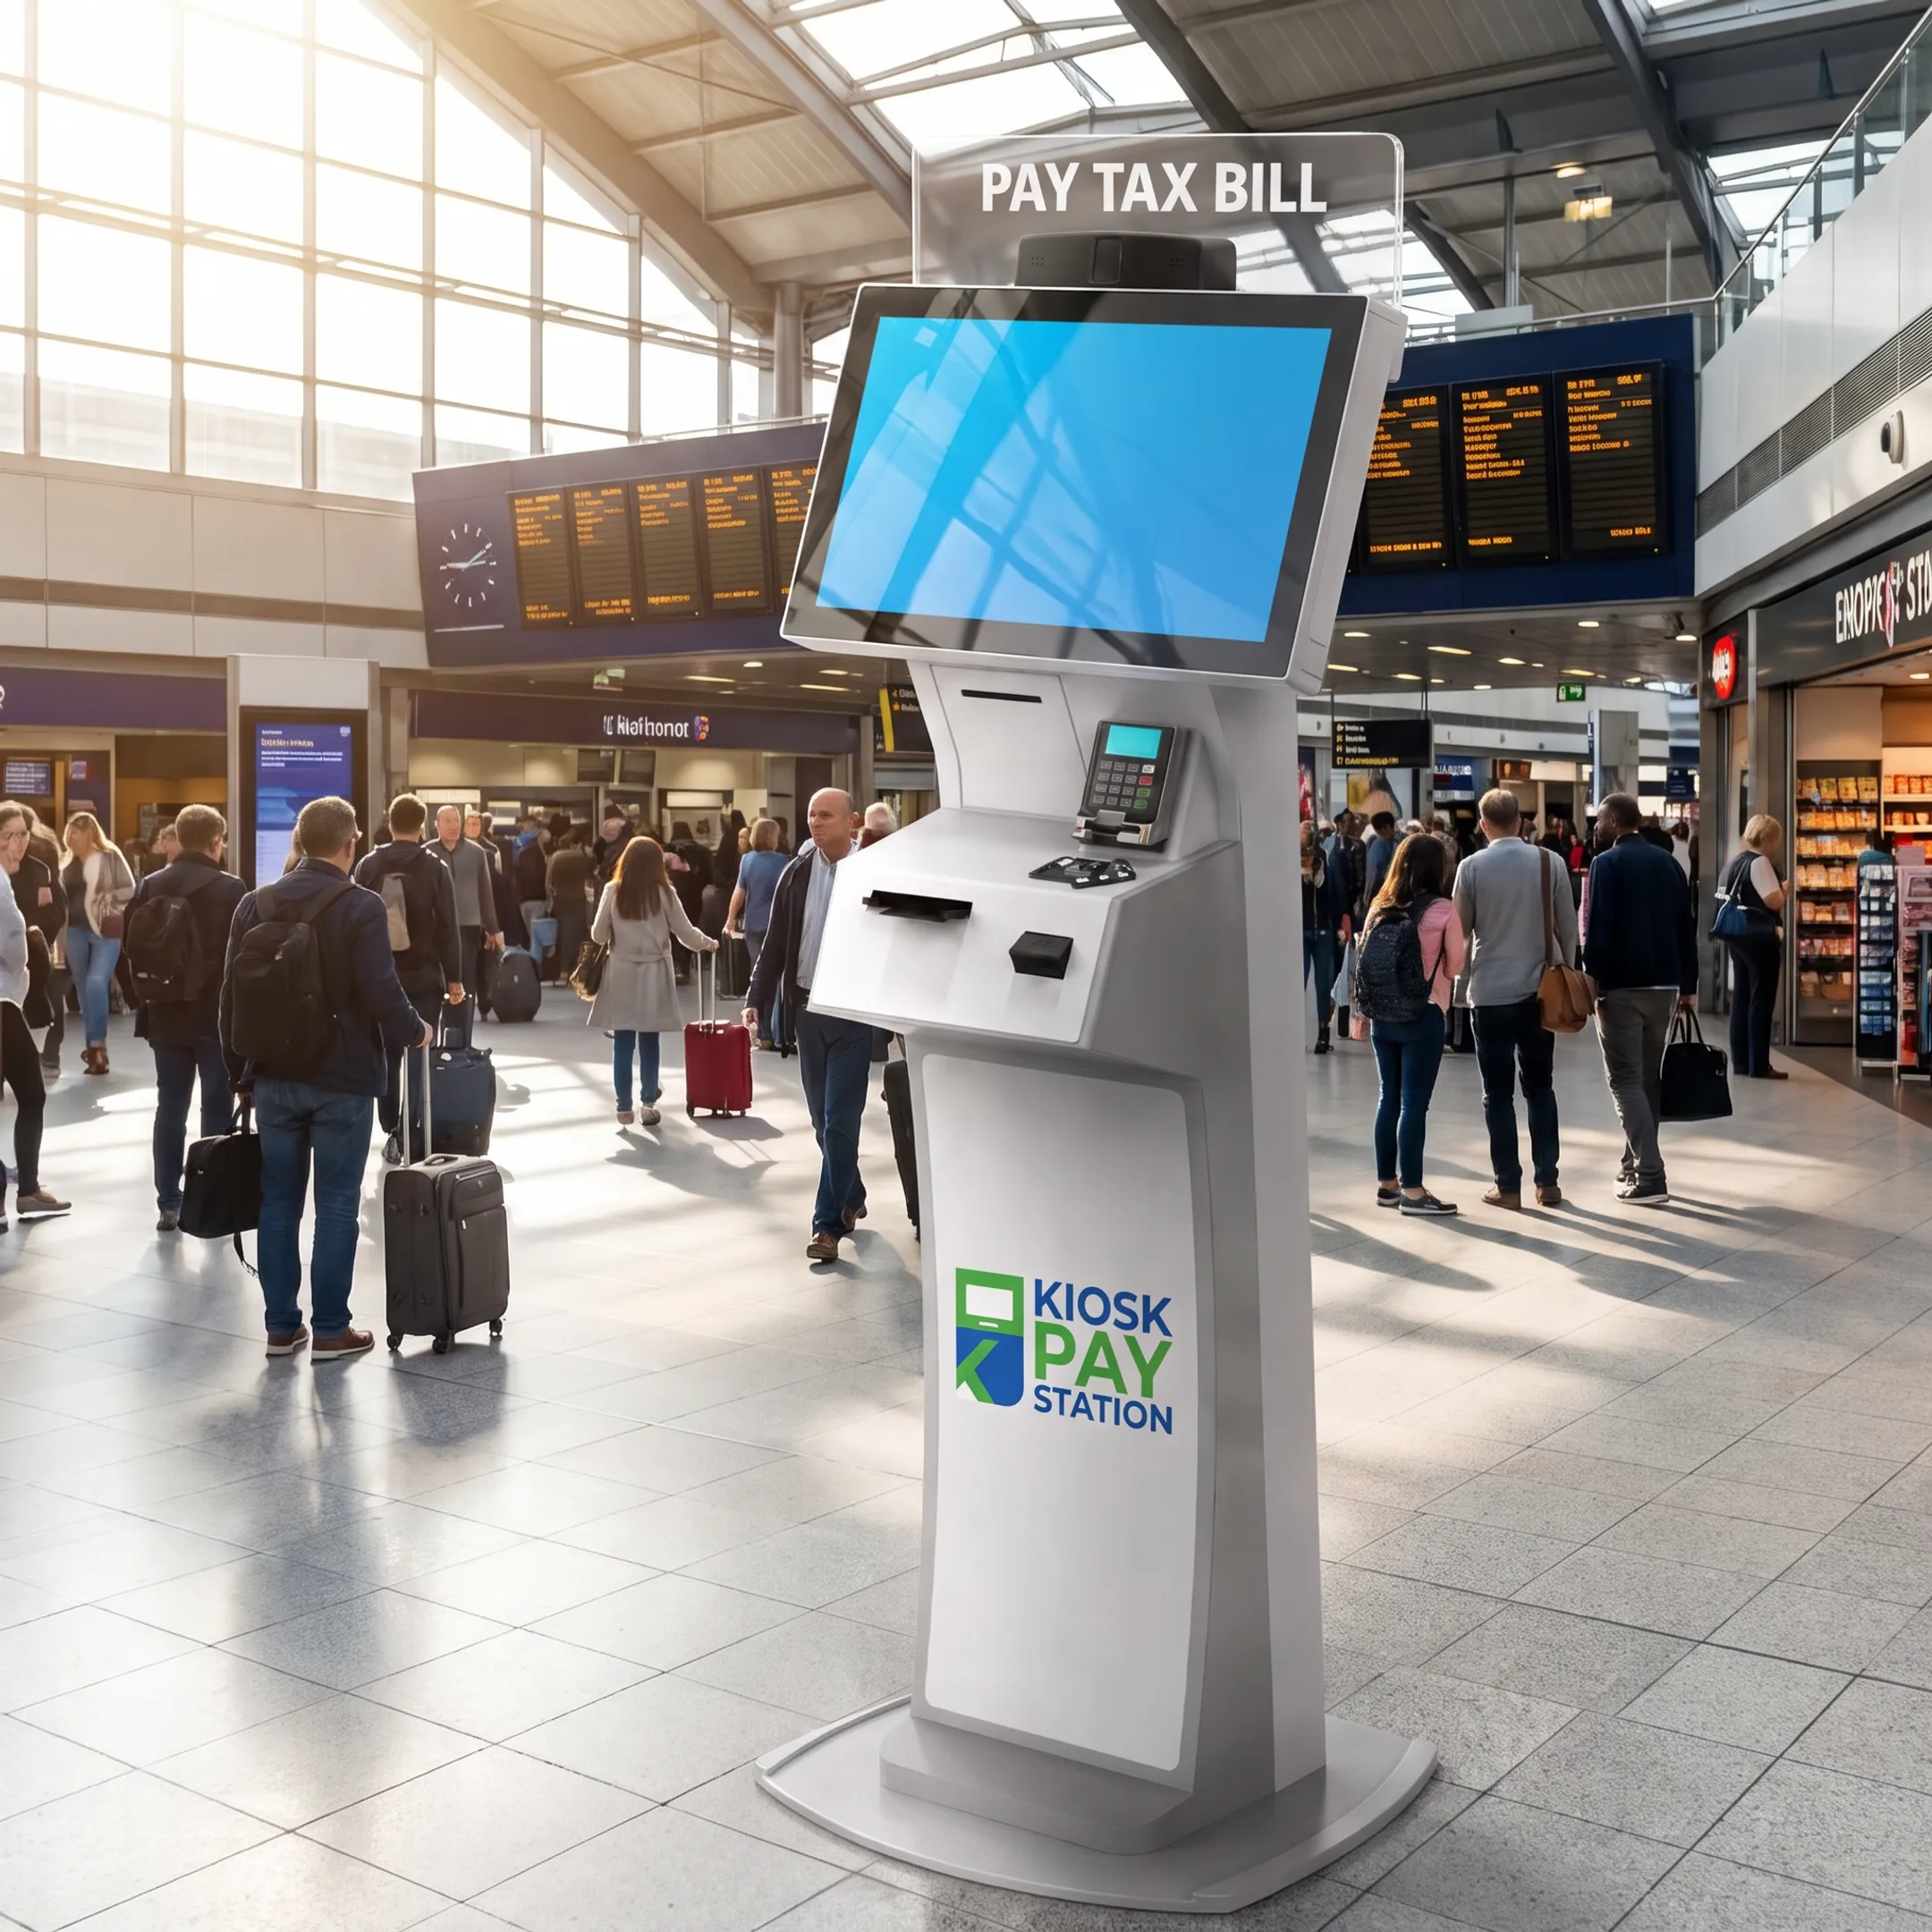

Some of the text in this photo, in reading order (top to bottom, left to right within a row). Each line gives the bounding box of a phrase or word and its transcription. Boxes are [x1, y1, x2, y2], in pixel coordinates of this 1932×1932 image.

[981, 162, 1327, 213] PAY TAX BILL
[1906, 549, 1932, 621] STO
[1034, 1278, 1174, 1337] KIOSK
[1035, 1320, 1174, 1399] PAY
[1033, 1384, 1174, 1435] STATION
